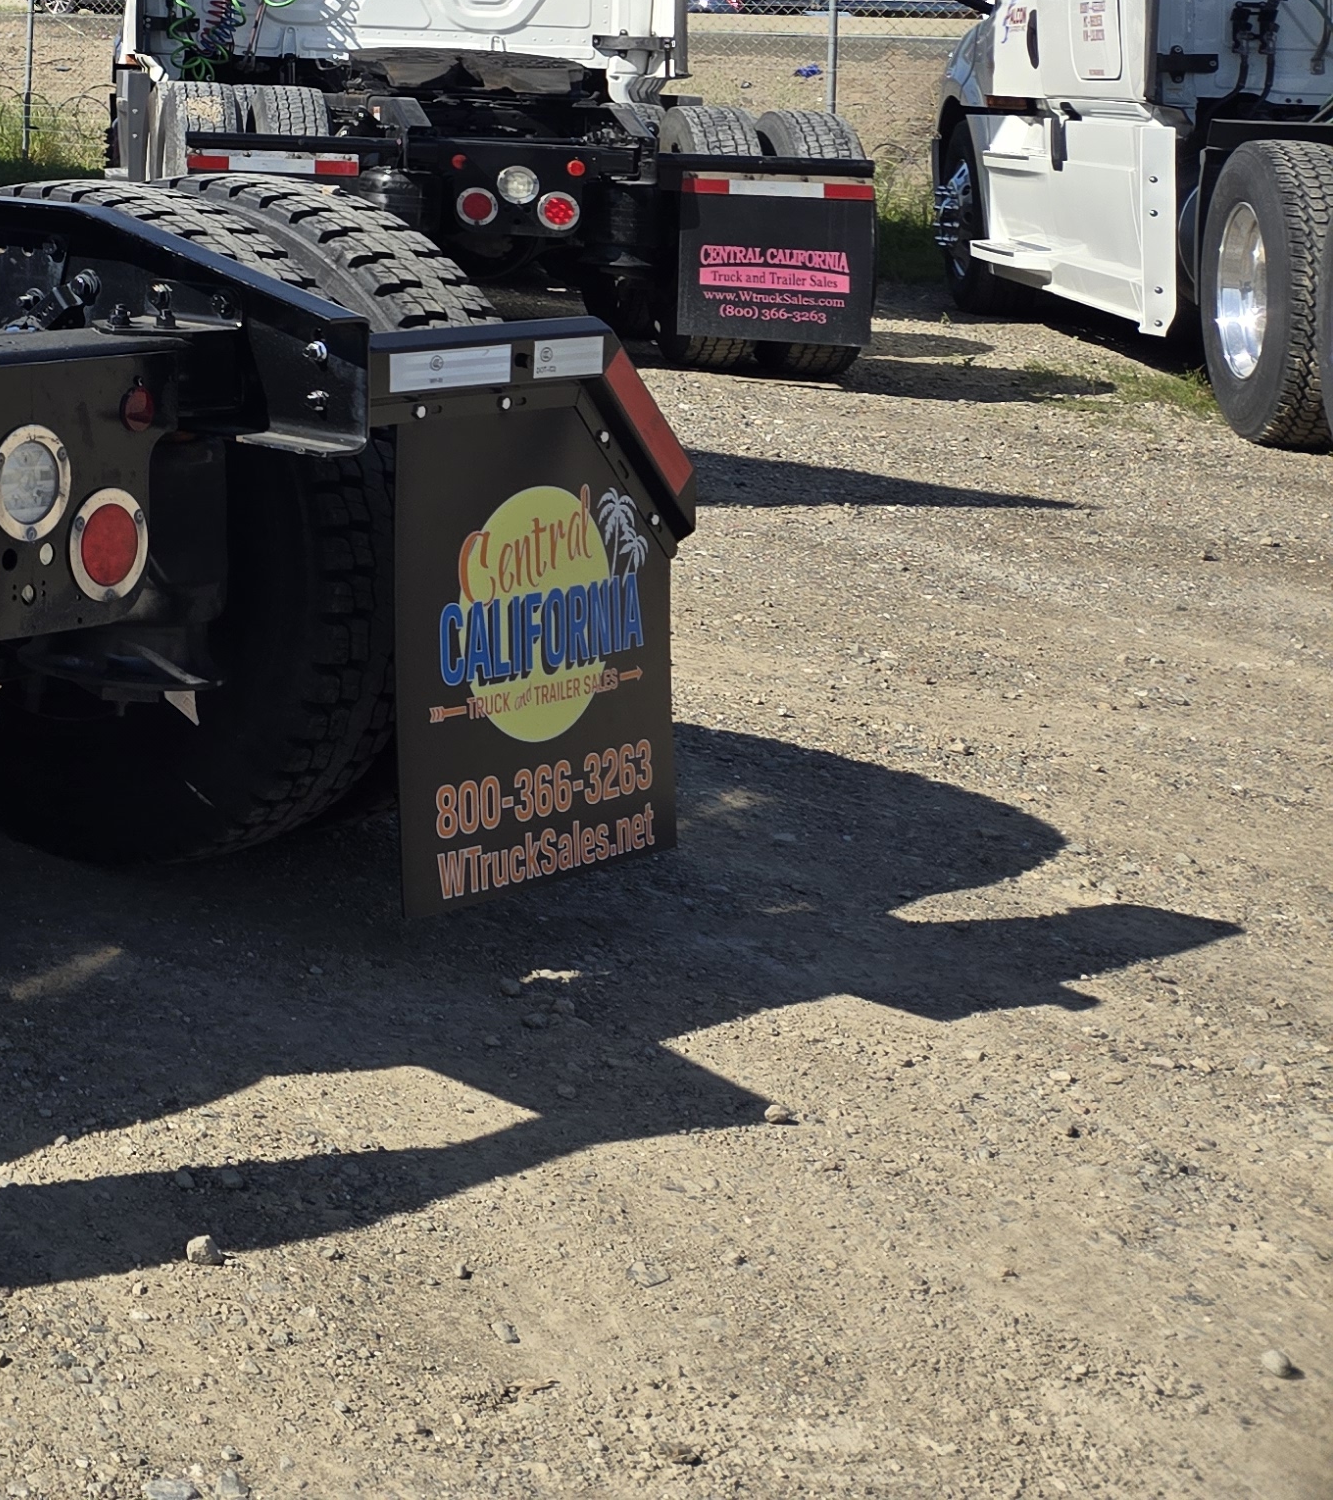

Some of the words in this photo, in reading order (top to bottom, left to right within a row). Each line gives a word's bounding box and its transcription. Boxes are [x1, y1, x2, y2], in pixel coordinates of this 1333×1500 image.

[700, 244, 764, 266] CENTRAL
[766, 247, 850, 273] CALIFORNIA
[710, 270, 743, 284] Truck
[745, 271, 766, 284] and
[769, 272, 806, 287] Trailer
[809, 275, 838, 289] Sales
[703, 290, 845, 308] www.WtruckSales.com
[719, 303, 759, 320] (800)
[761, 306, 827, 324] 366-3263
[458, 484, 592, 607] Central
[439, 572, 644, 687] CALIFORNIA
[466, 691, 511, 720] TRUCK
[514, 685, 533, 713] and
[534, 678, 582, 707] TRAILER
[583, 667, 619, 695] SALES
[435, 739, 653, 839] 800-366-3263
[436, 803, 655, 900] WTruckSales.net
